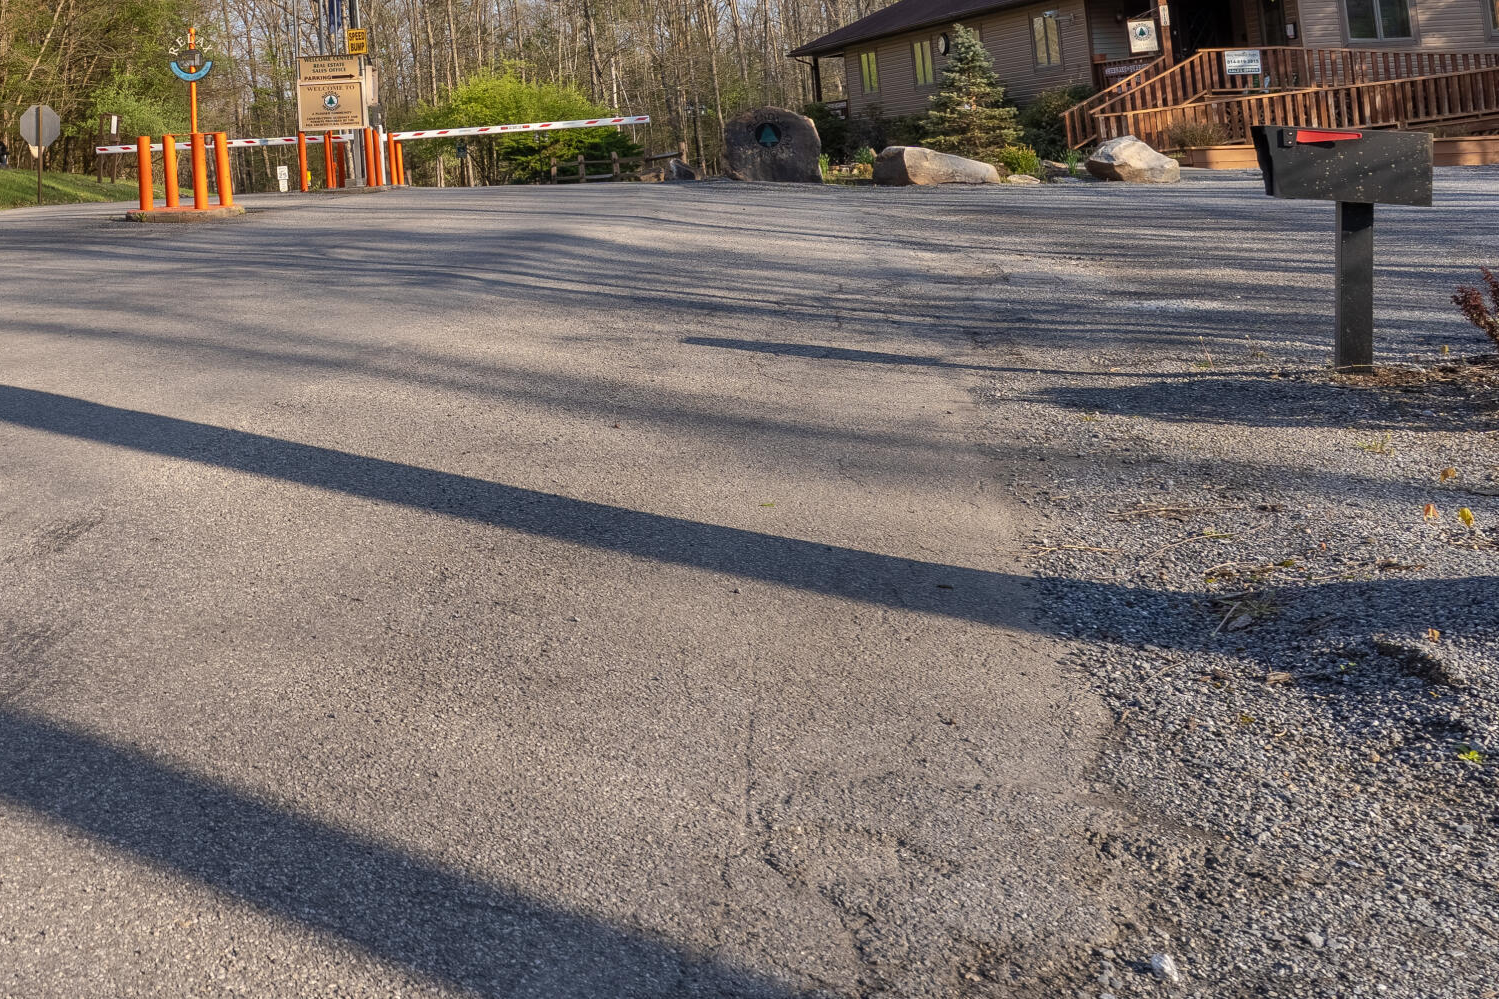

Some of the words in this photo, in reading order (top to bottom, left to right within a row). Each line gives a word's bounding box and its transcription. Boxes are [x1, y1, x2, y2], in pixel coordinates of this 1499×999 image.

[349, 31, 364, 40] SPEED
[168, 33, 213, 56] RELAX
[351, 42, 365, 51] BUMP
